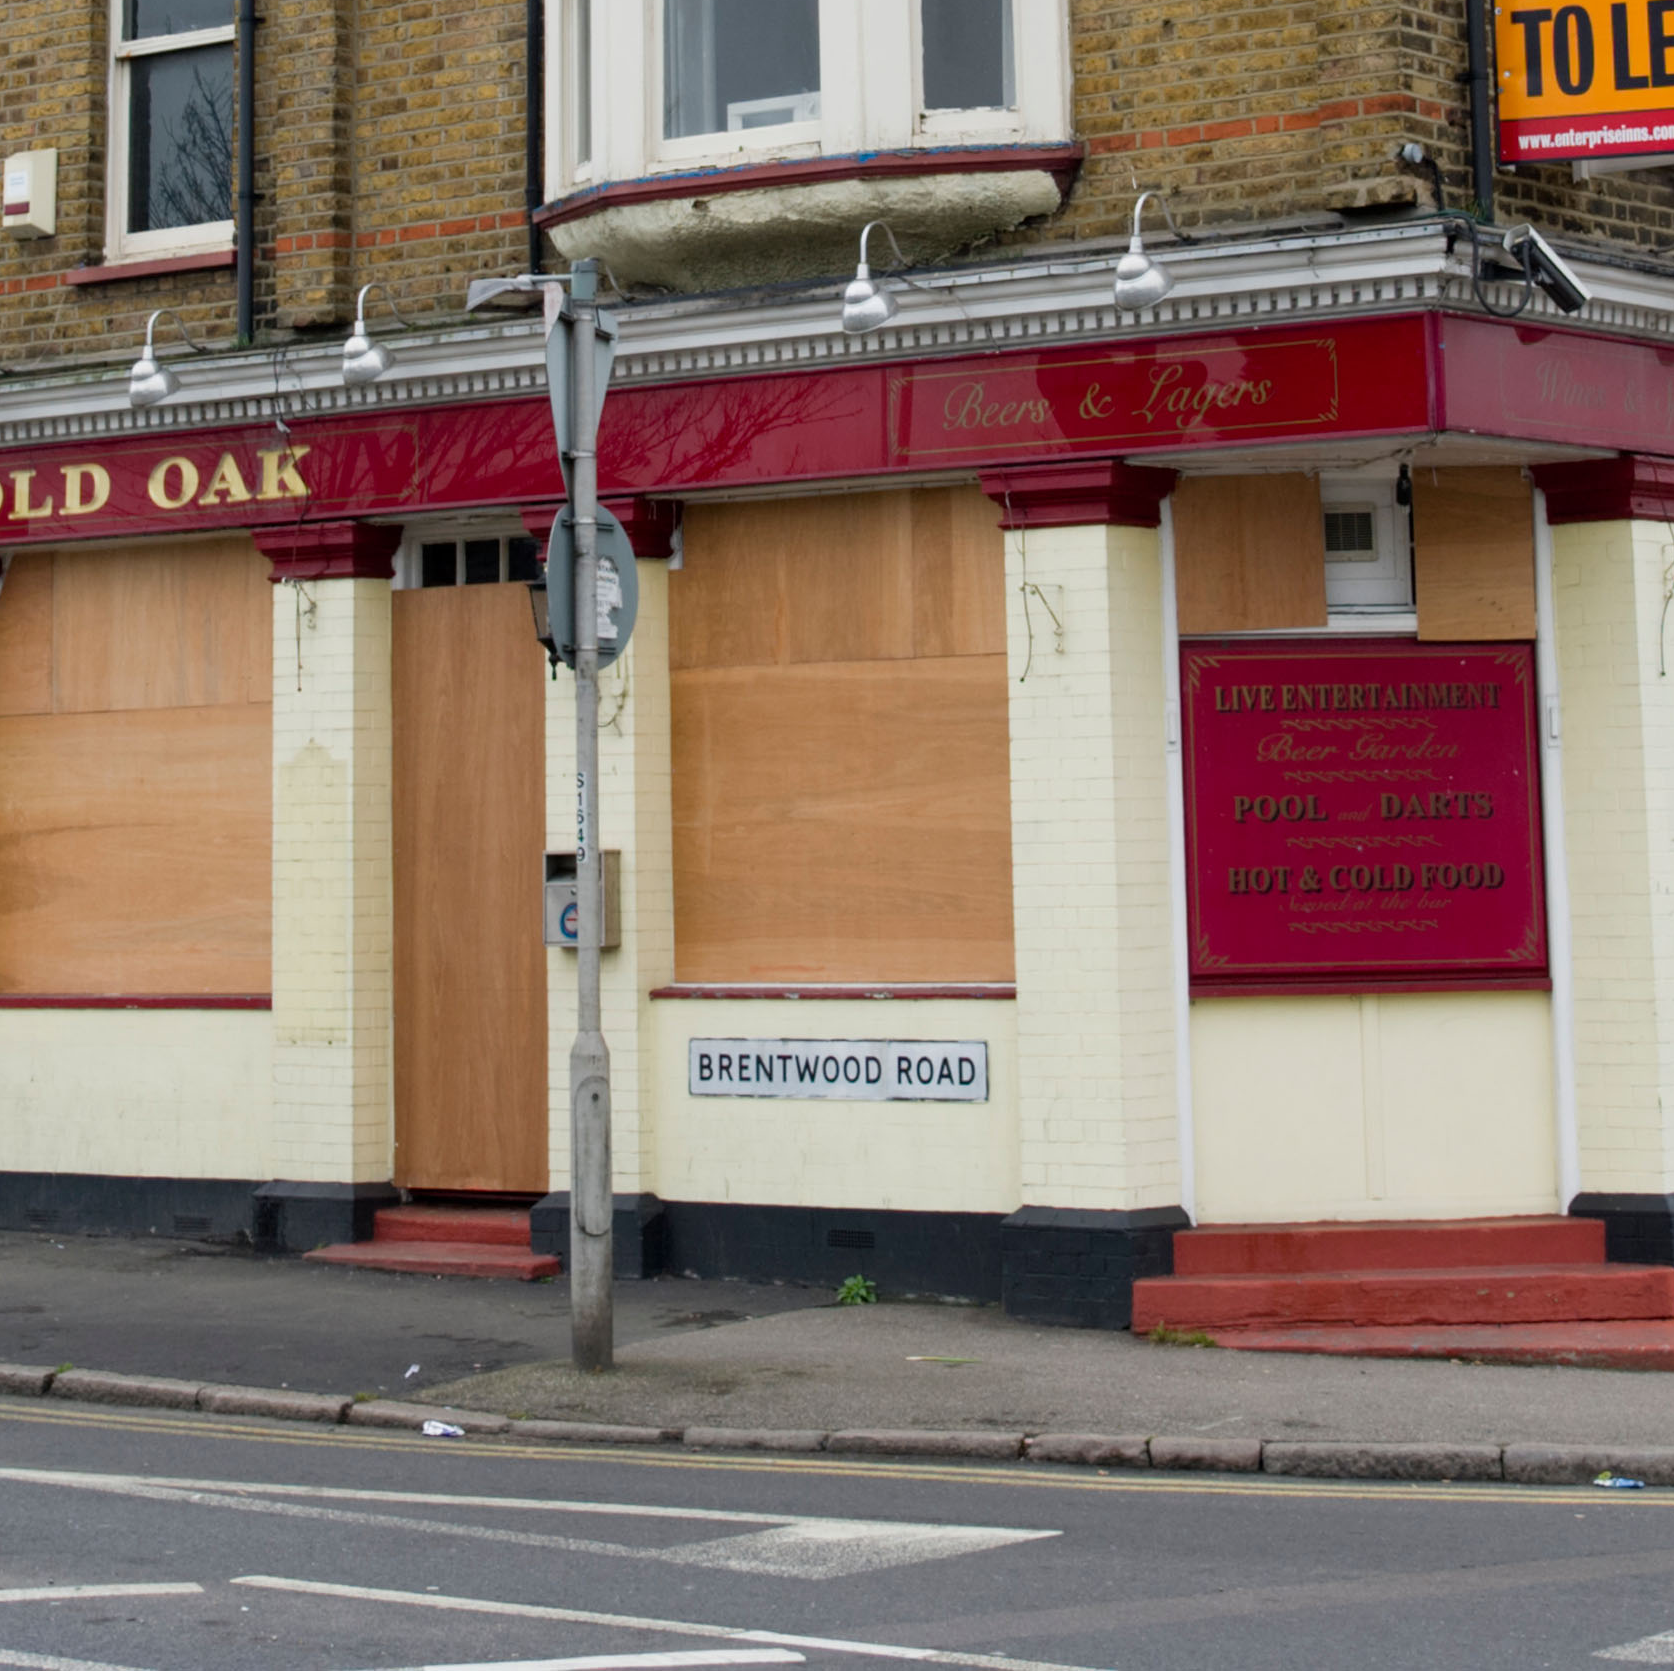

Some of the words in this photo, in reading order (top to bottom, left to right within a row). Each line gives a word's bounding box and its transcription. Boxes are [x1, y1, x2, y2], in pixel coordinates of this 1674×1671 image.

[1510, 4, 1595, 98] TO
[943, 382, 1053, 431] Beers
[1079, 382, 1115, 420] &
[1131, 364, 1274, 429] Lagers
[1535, 360, 1607, 410] Wines
[146, 445, 312, 510] OAK
[1214, 684, 1277, 713] LIVE
[1281, 682, 1502, 713] ENTERTAINMENT
[1256, 732, 1340, 762] Beer
[1348, 732, 1460, 761] Garden
[1233, 794, 1329, 823] POOL
[1337, 803, 1374, 822] and
[1380, 791, 1495, 820] DARTS
[1228, 865, 1293, 894] HOT
[1298, 865, 1322, 892] &
[1329, 864, 1416, 892] COLD
[1421, 862, 1506, 890] FOOD
[1279, 890, 1351, 913] Served
[1380, 891, 1410, 911] the
[1417, 891, 1453, 910] bar
[698, 1053, 882, 1084] BRENTWOOD
[897, 1055, 977, 1086] ROAD
